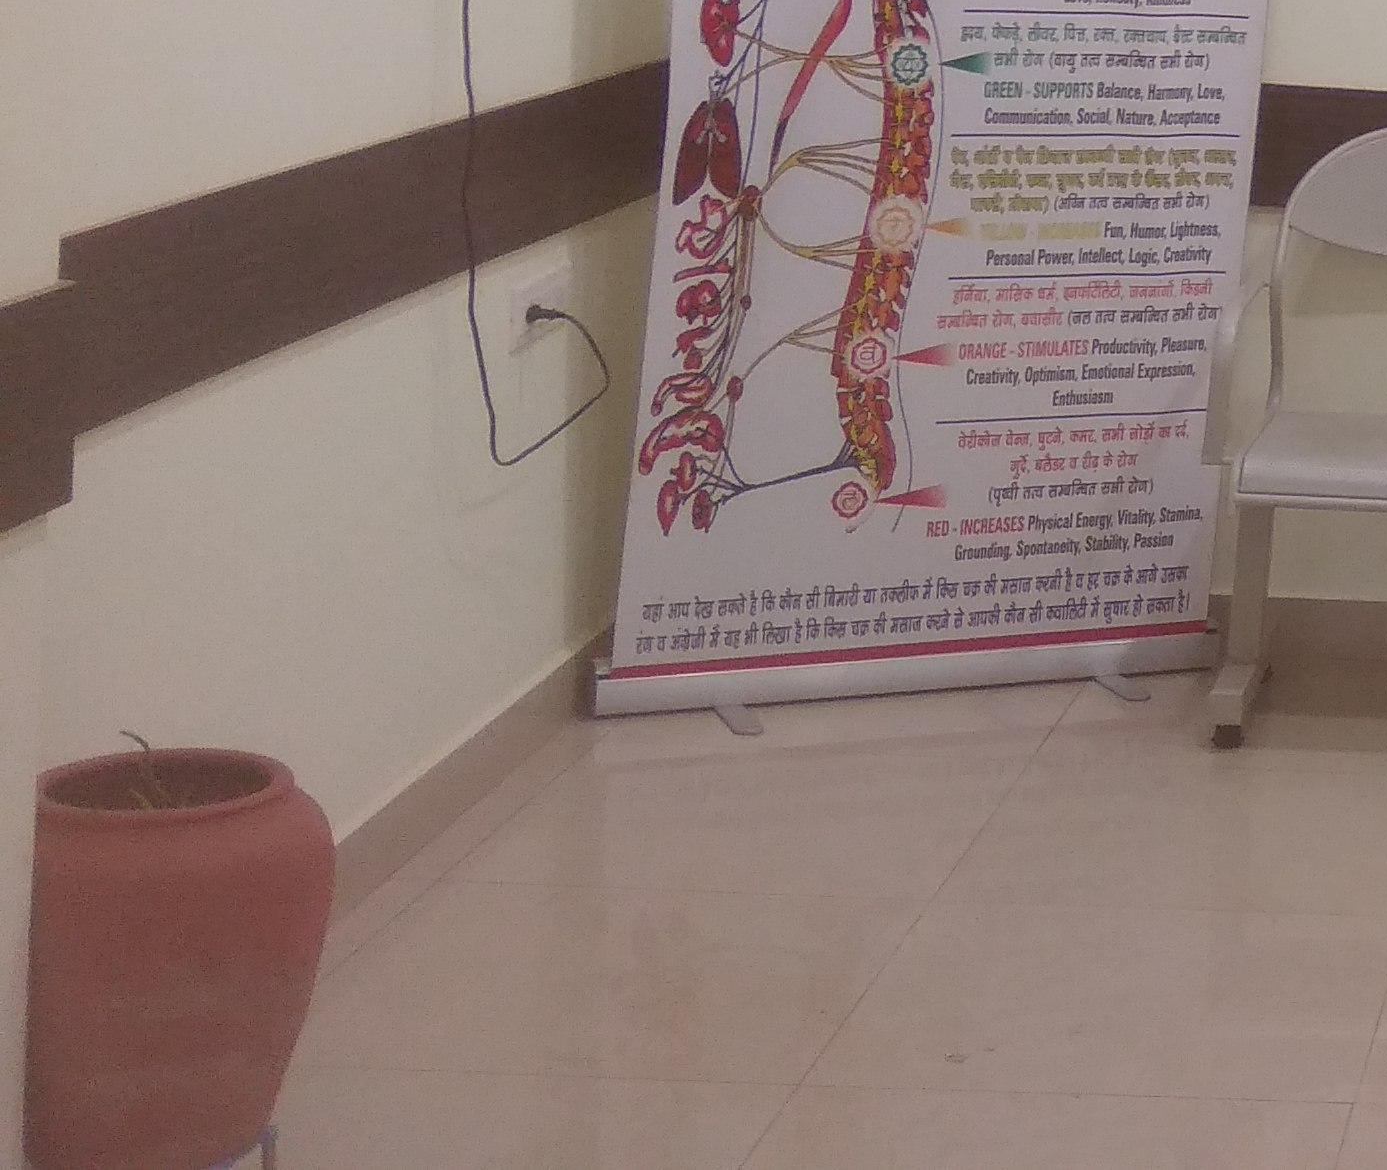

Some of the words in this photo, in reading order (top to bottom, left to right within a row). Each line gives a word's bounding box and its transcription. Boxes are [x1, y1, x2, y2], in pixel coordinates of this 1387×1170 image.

[984, 81, 1023, 99] GREEN
[1033, 82, 1094, 99] SUPPORTS
[1096, 82, 1144, 102] Balance,
[1147, 83, 1194, 103] Harmony,
[1197, 83, 1225, 101] Love,
[984, 107, 1073, 125] Communication,
[1077, 107, 1111, 125] Social,
[1116, 107, 1157, 126] Nature,
[1159, 109, 1221, 128] Acceptance
[1104, 221, 1127, 240] Fun,
[1130, 221, 1167, 239] Humor,
[1170, 220, 1221, 241] Lightness,
[986, 249, 1035, 266] Personal
[1037, 248, 1075, 266] Power,
[1079, 247, 1125, 265] Intellect,
[1128, 247, 1160, 268] Logic,
[1163, 245, 1212, 265] Creativity
[958, 342, 1007, 360] ORANGE
[1017, 340, 1089, 358] STIMULATES
[1092, 338, 1158, 357] Productivity,
[1161, 337, 1207, 352] Pleasure,
[966, 367, 1020, 386] Creativity,
[1024, 365, 1078, 386] Optimism,
[1081, 363, 1135, 380] Emotional
[1137, 361, 1196, 382] Expression,
[1052, 389, 1114, 406] Enthusiasm
[926, 520, 950, 538] RED
[960, 515, 1025, 536] INCREASES
[1027, 512, 1073, 534] Physical
[1075, 512, 1113, 530] Energy,
[1118, 508, 1156, 528] Vitality,
[1160, 505, 1203, 523] Stamina,
[954, 542, 1013, 562] Grounding,
[1016, 538, 1081, 560] Spontaneity,
[1085, 533, 1130, 554] Stability,
[1133, 532, 1174, 549] Passion
